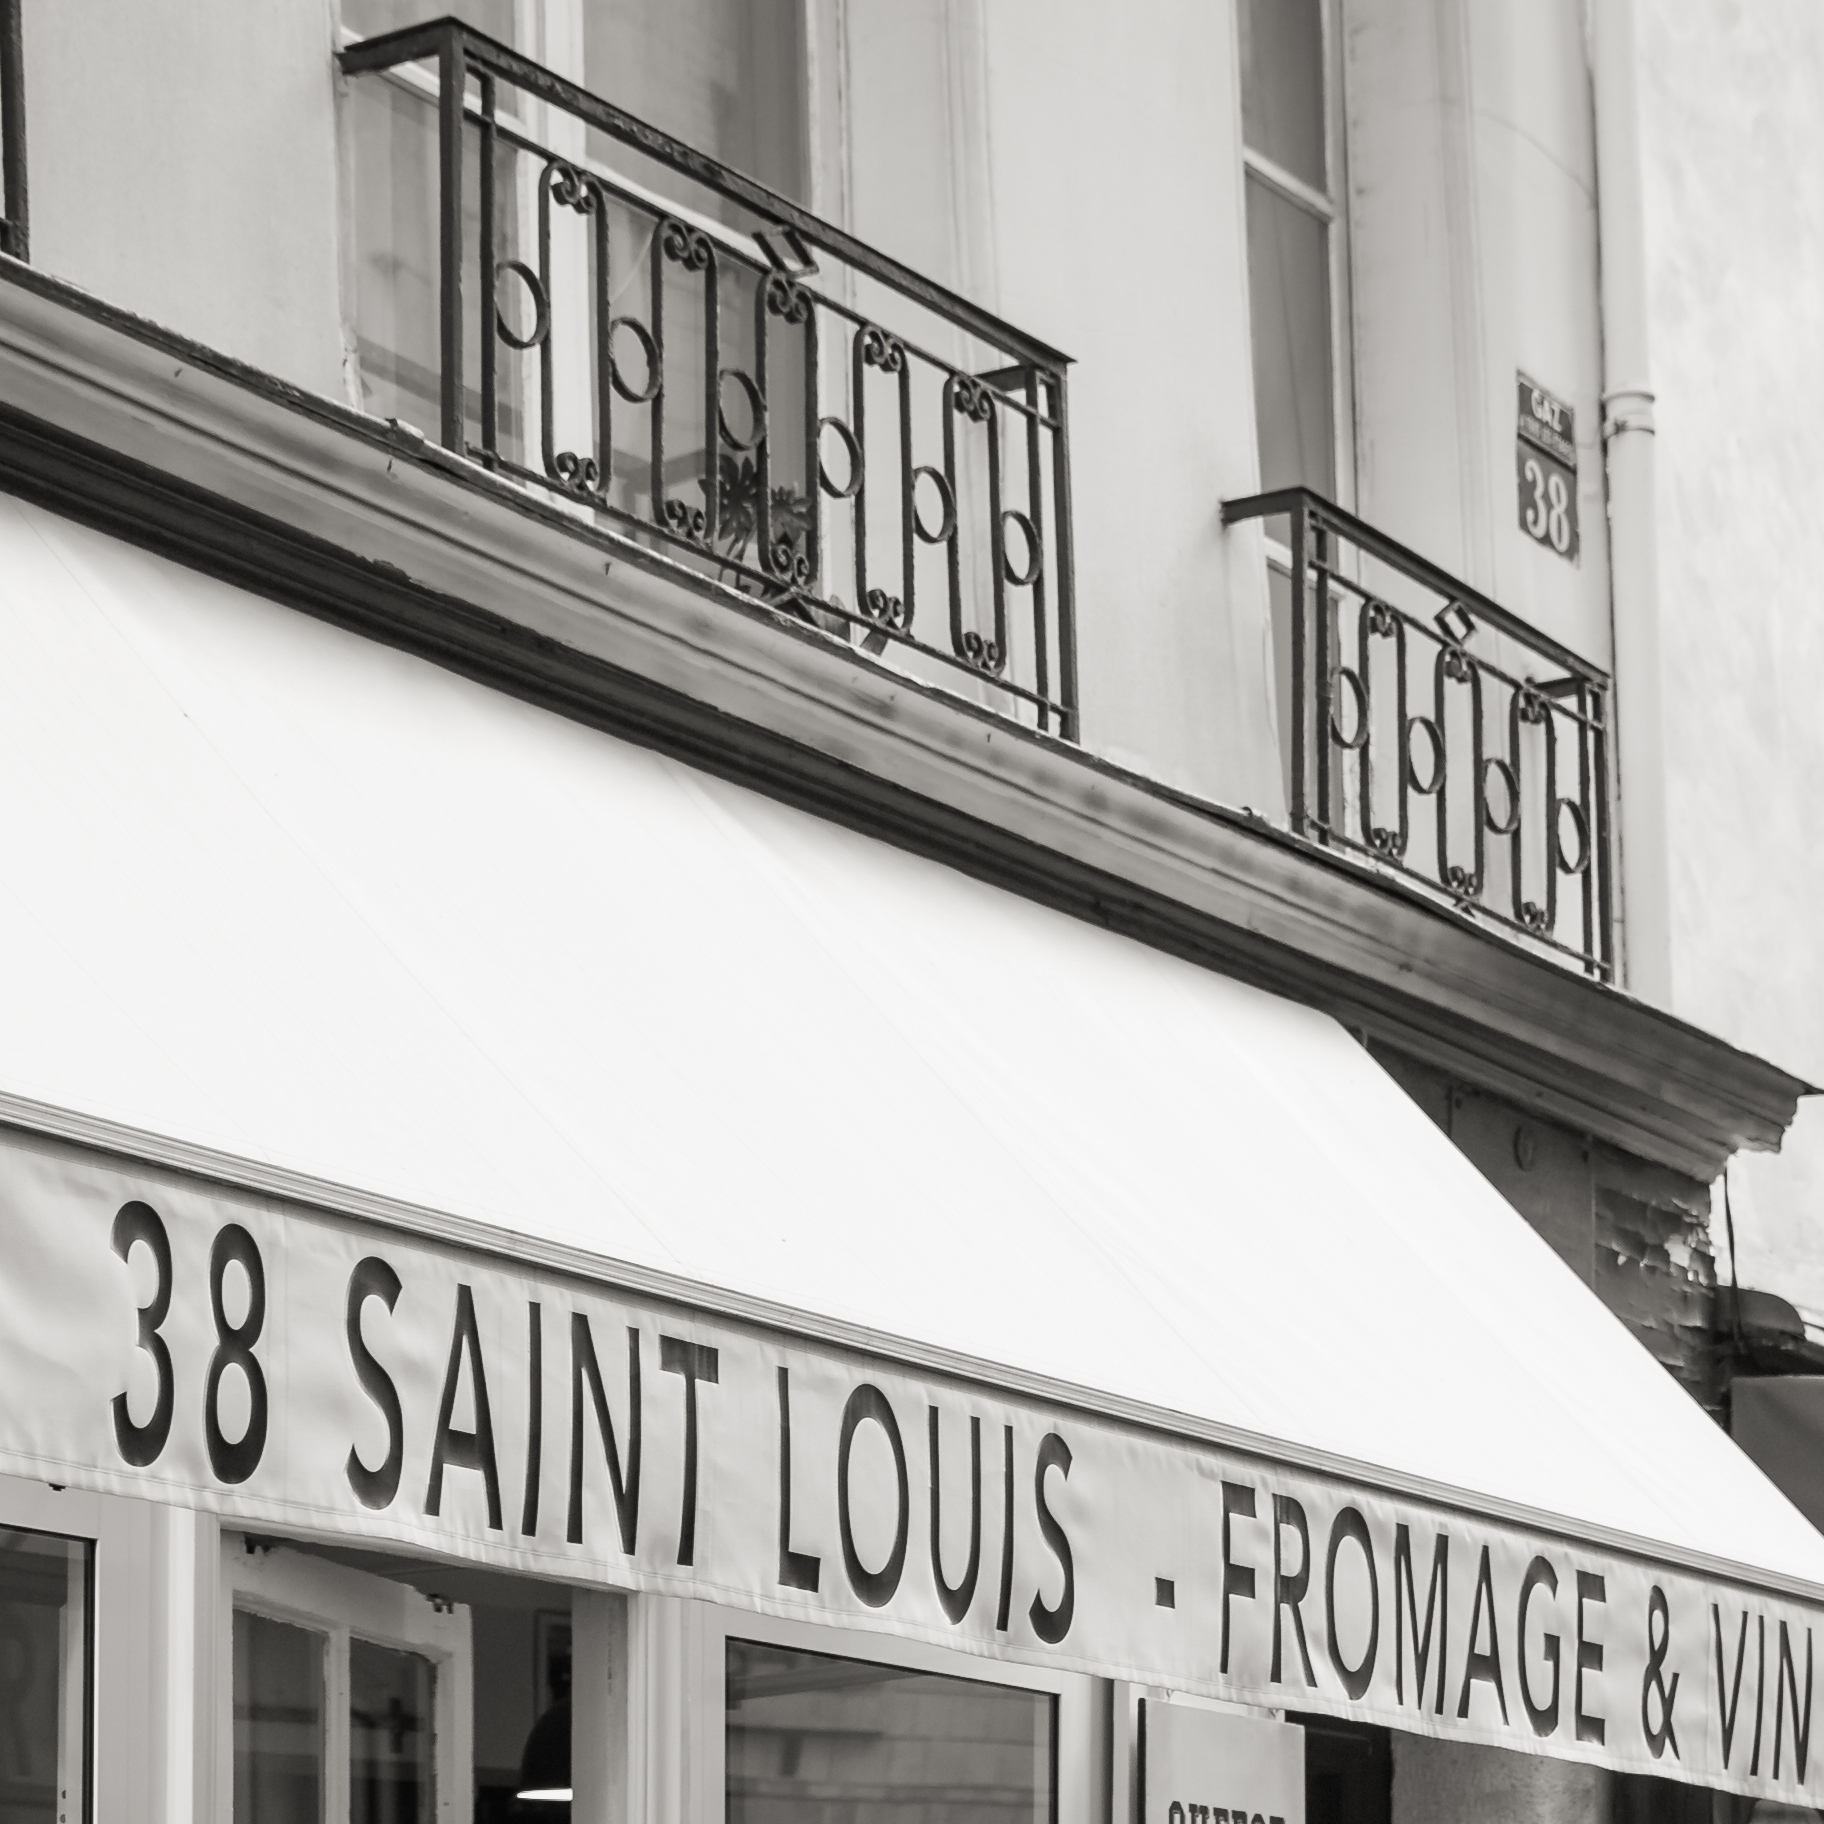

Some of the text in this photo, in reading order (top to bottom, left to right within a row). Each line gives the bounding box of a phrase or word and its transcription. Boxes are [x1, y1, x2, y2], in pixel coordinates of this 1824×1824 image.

[1524, 458, 1570, 553] 38
[108, 1200, 269, 1484] 38
[345, 1256, 720, 1566] SAINT
[776, 1366, 1075, 1647] LOUIS
[1219, 1480, 1607, 1746] FROMAGE
[1641, 1585, 1681, 1762] &
[1711, 1602, 1813, 1786] VIN
